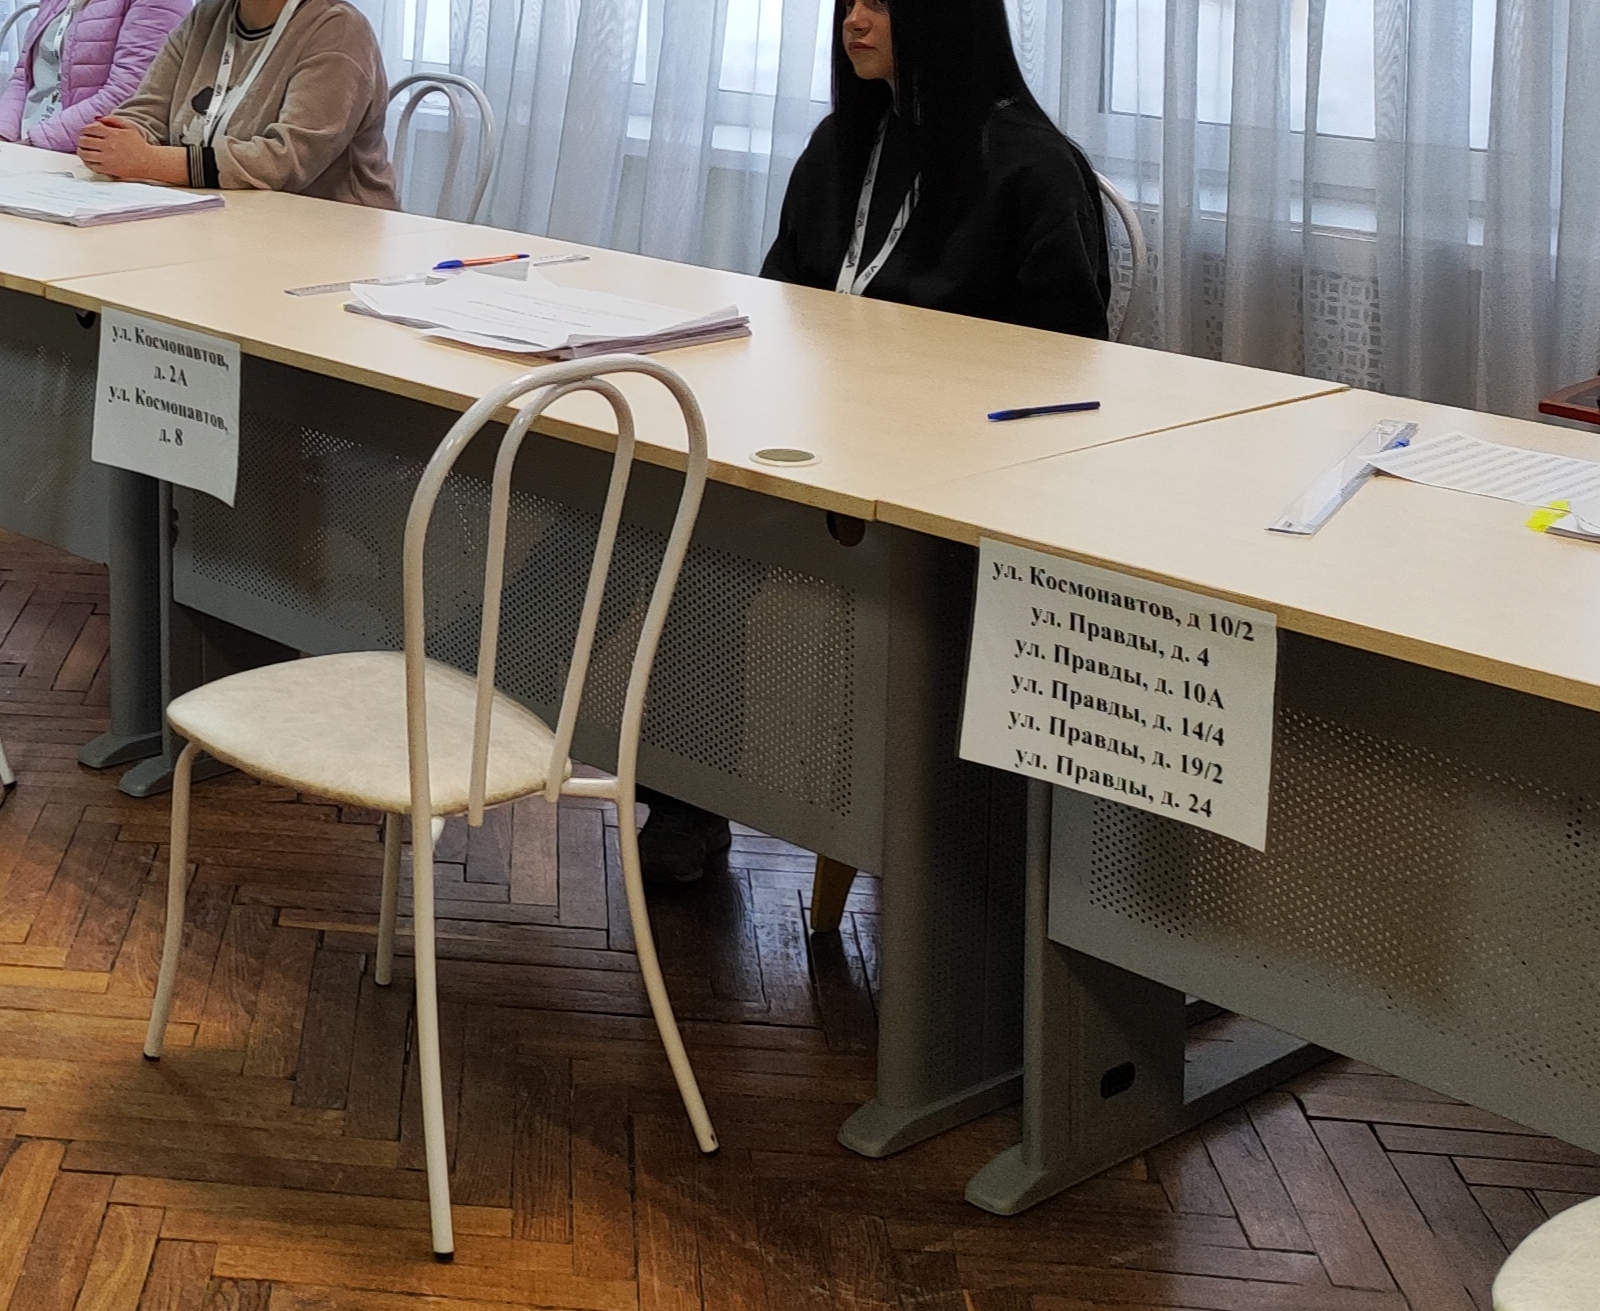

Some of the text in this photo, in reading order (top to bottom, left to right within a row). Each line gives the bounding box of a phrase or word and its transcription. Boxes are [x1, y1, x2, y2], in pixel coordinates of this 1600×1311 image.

[112, 326, 229, 372] ул. Космонавтов,
[154, 365, 188, 387] д. 2А
[108, 386, 228, 435] ул. Космонавтов,
[159, 428, 183, 446] д. 8
[992, 561, 1254, 641] ул. Космонавтов, д 10/2
[1031, 607, 1209, 667] ул. Правды, д. 4
[1014, 639, 1225, 709] ул. Правды, д. 10А
[1010, 675, 1225, 746] ул. Правды, д. 14/4
[1008, 711, 1223, 784] ул. Правды, д. 19/2
[1014, 749, 1212, 817] ул. Правды, д. 24
